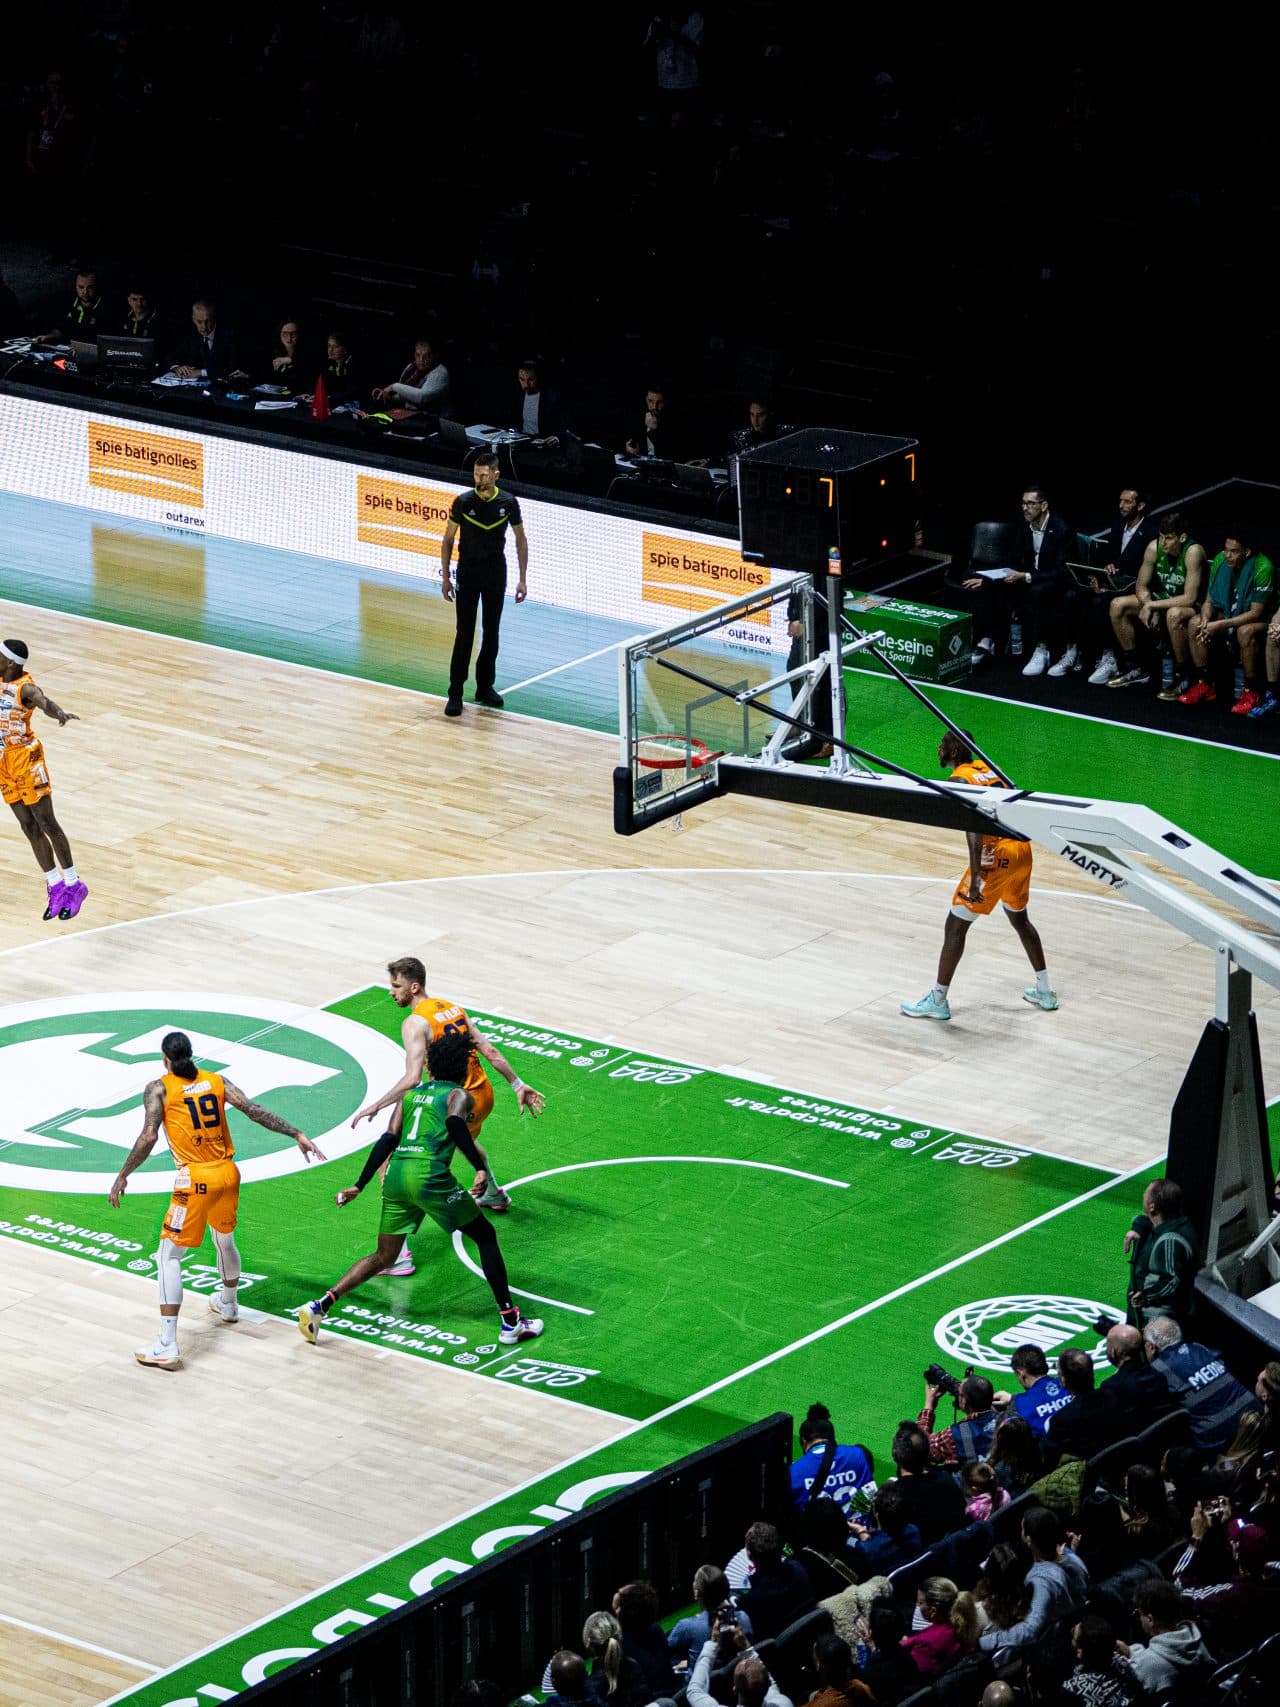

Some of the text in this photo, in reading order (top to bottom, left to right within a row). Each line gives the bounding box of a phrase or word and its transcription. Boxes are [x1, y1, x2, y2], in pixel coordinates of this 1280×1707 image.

[95, 439, 197, 471] spie batignolles
[166, 511, 205, 527] outarex
[365, 493, 450, 520] spie batigno
[650, 551, 763, 585] spie batignolles
[728, 627, 772, 646] outarex
[888, 649, 916, 665] Sportif
[997, 858, 1010, 869] 12
[1060, 845, 1124, 886] MARTY
[184, 1093, 220, 1130] 19
[407, 1107, 423, 1140] 1
[725, 1097, 882, 1140] www.cpa78.fr
[195, 1183, 207, 1194] 19
[804, 1470, 857, 1490] POTO
